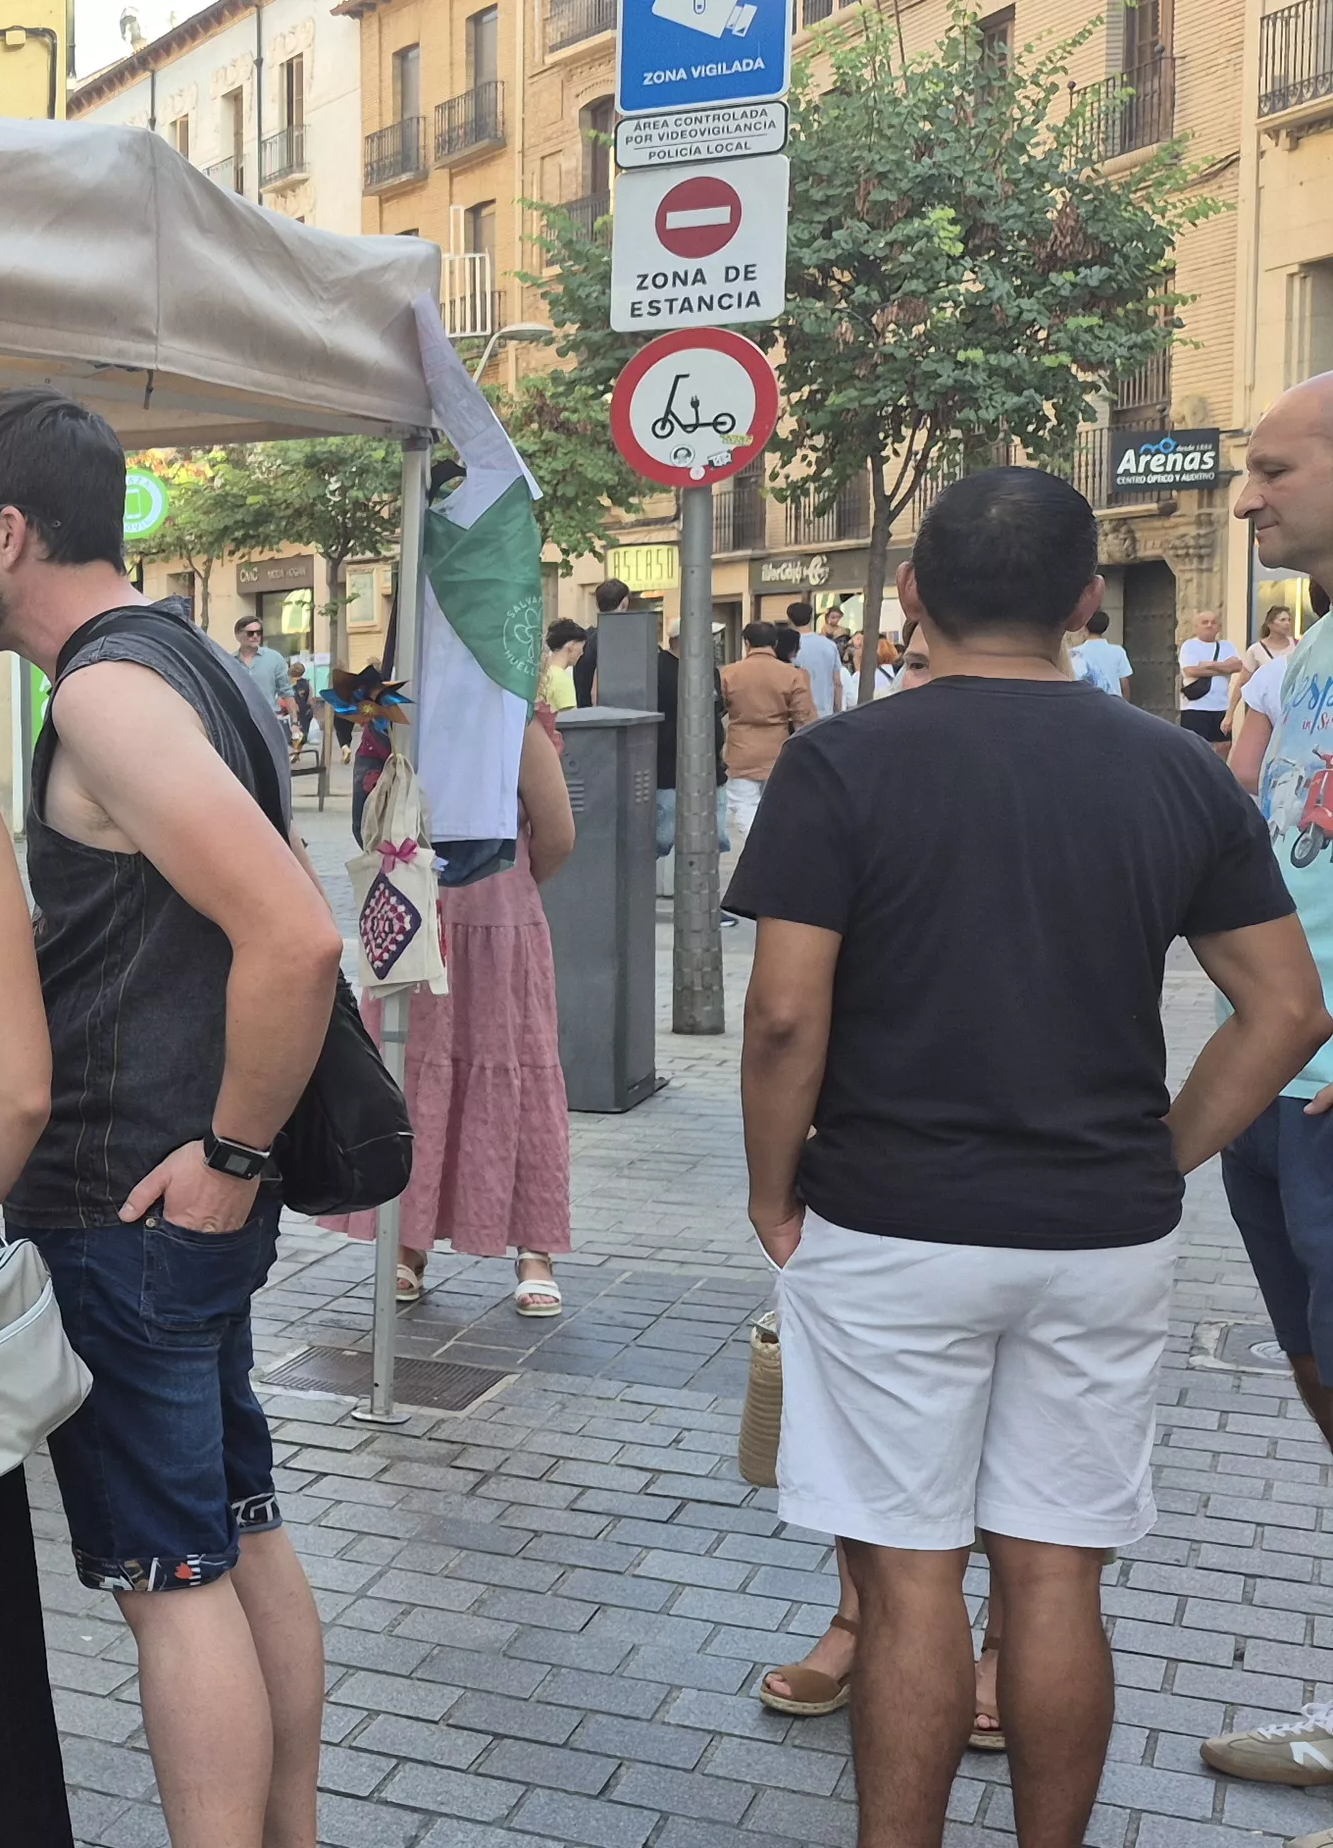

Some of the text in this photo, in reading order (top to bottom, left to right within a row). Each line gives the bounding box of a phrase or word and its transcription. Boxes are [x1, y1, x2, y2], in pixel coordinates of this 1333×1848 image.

[642, 56, 766, 86] ZONA VIGILADA
[625, 119, 777, 146] POR VIDEOVIGILANCIA
[633, 107, 769, 132] ÁREA CONTROLADA
[648, 140, 752, 161] POLICÍA LOCAL
[635, 263, 757, 291] ZONA DE
[629, 290, 761, 319] ESTANCIA
[1116, 448, 1216, 475] Arenas
[1116, 472, 1215, 485] CENTRO ÓPTICO Y AUDITIVO
[613, 547, 674, 582] ASCASO
